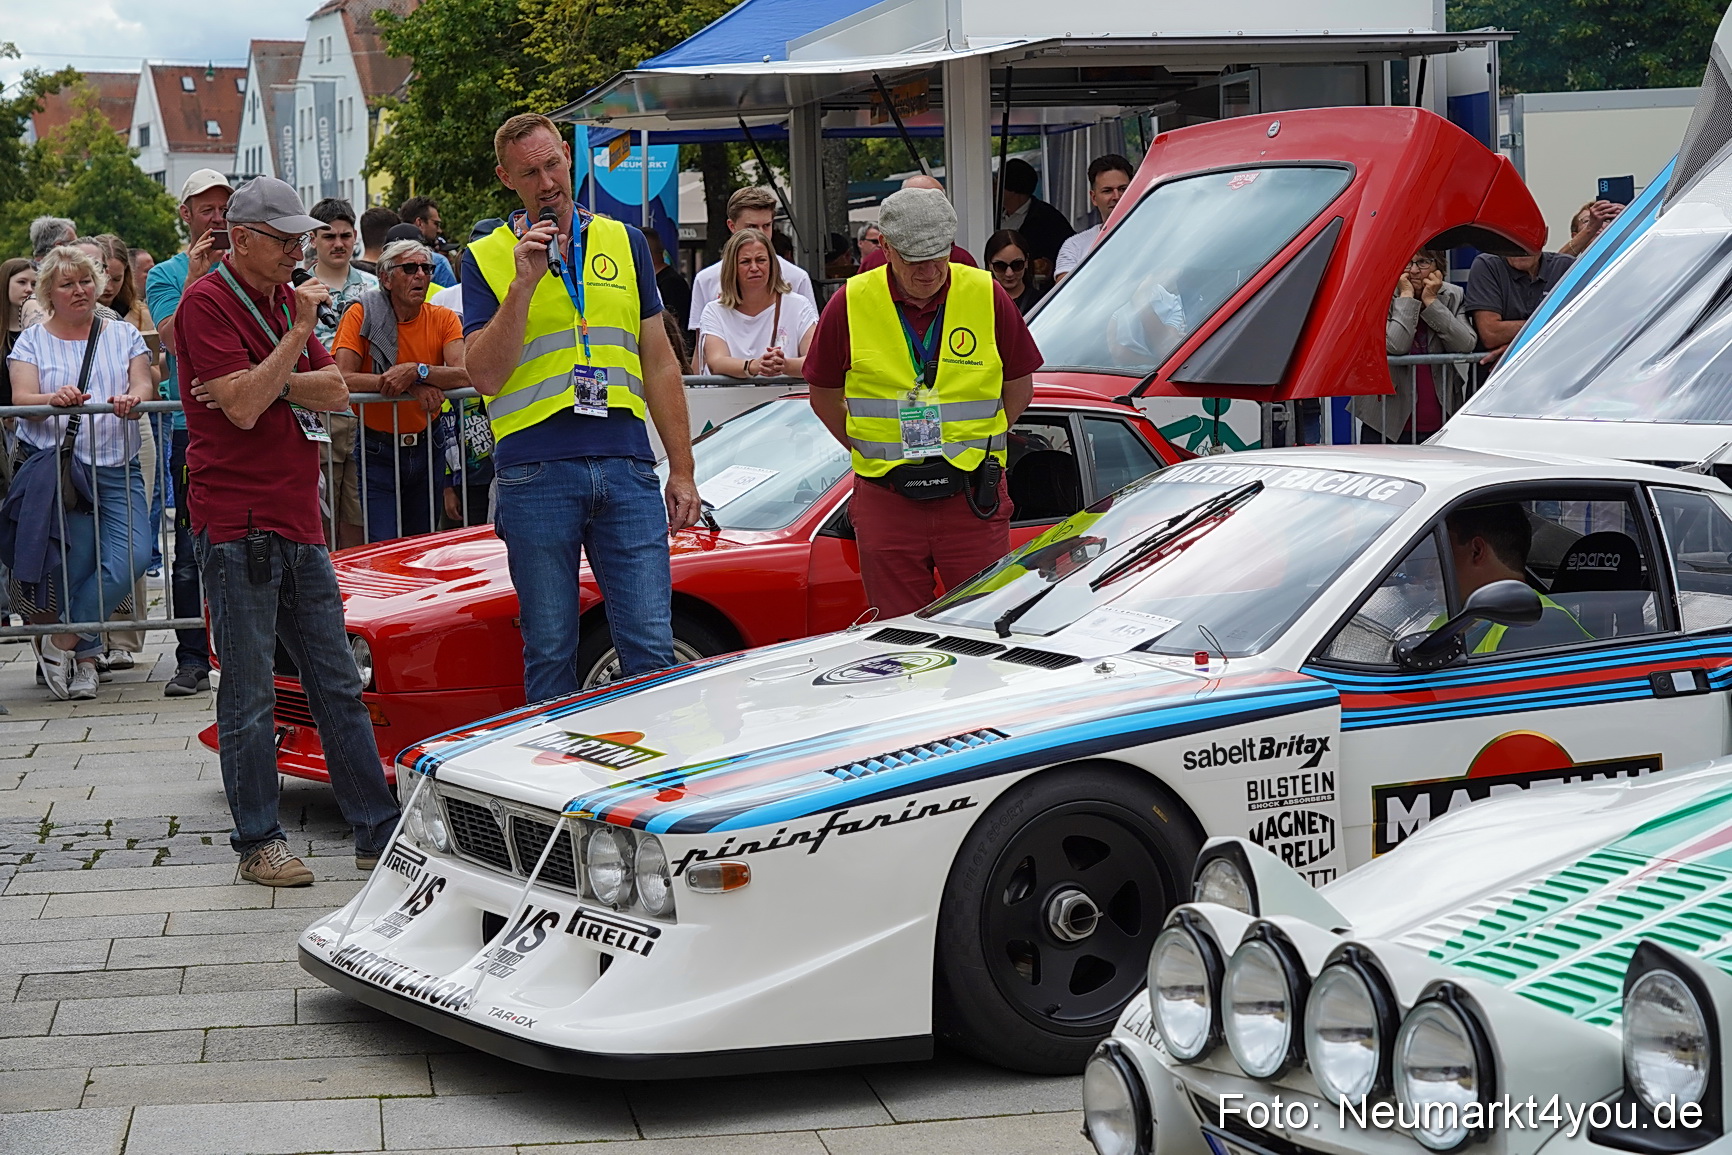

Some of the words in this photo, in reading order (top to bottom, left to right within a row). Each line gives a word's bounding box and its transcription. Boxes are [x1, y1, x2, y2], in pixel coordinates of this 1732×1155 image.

[319, 116, 332, 180] SCHMID
[471, 430, 491, 447] AND
[1158, 465, 1275, 487] MARTINI
[1274, 469, 1406, 501] RACING
[1567, 552, 1621, 571] sparco
[527, 733, 654, 768] MARTINI
[1183, 738, 1257, 770] sabelt
[1258, 734, 1331, 770] Britax
[1247, 771, 1335, 801] BILSTEIN
[1251, 800, 1280, 810] SHOCK
[1283, 794, 1333, 806] ABSORBERS
[671, 796, 979, 877] pininfarina
[383, 842, 428, 882] PIRELLI
[399, 872, 447, 917] VS
[502, 904, 561, 953] VS
[564, 906, 662, 958] PIRELLI
[331, 944, 398, 989] MARTINI
[393, 967, 473, 1012] LANCIA
